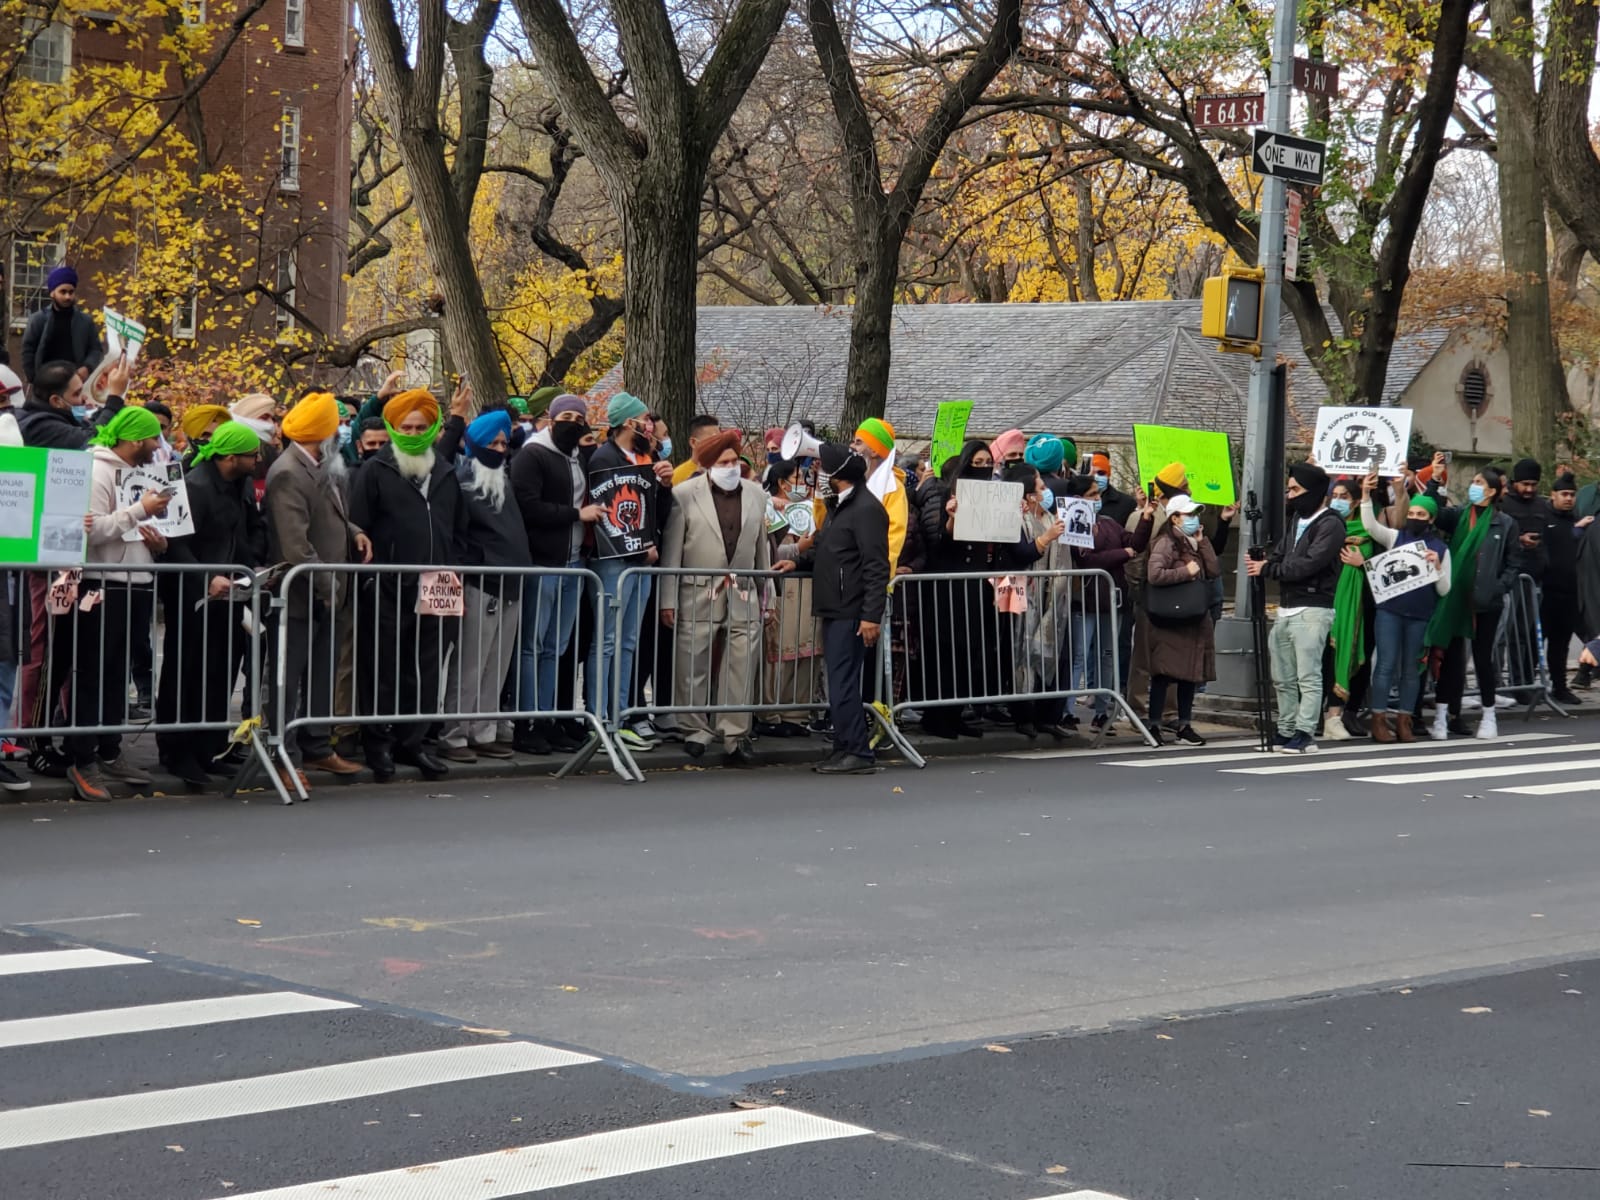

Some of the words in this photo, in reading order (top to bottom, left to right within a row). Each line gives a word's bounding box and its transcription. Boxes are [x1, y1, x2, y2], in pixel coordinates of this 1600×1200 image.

[1303, 67, 1310, 88] 5
[1313, 70, 1327, 92] Av
[1203, 104, 1212, 125] E
[1218, 102, 1236, 124] 64
[1243, 100, 1259, 123] St
[1264, 144, 1286, 165] ONE
[1295, 150, 1317, 172] WAY
[1328, 411, 1358, 430] SUPPORT
[1361, 410, 1378, 418] OUR
[52, 457, 64, 465] NO
[51, 467, 87, 477] FARMERS
[51, 477, 63, 485] NO
[63, 478, 85, 487] FOOD
[437, 572, 451, 584] NO
[422, 585, 462, 597] PARKING
[428, 598, 457, 609] TODAY
